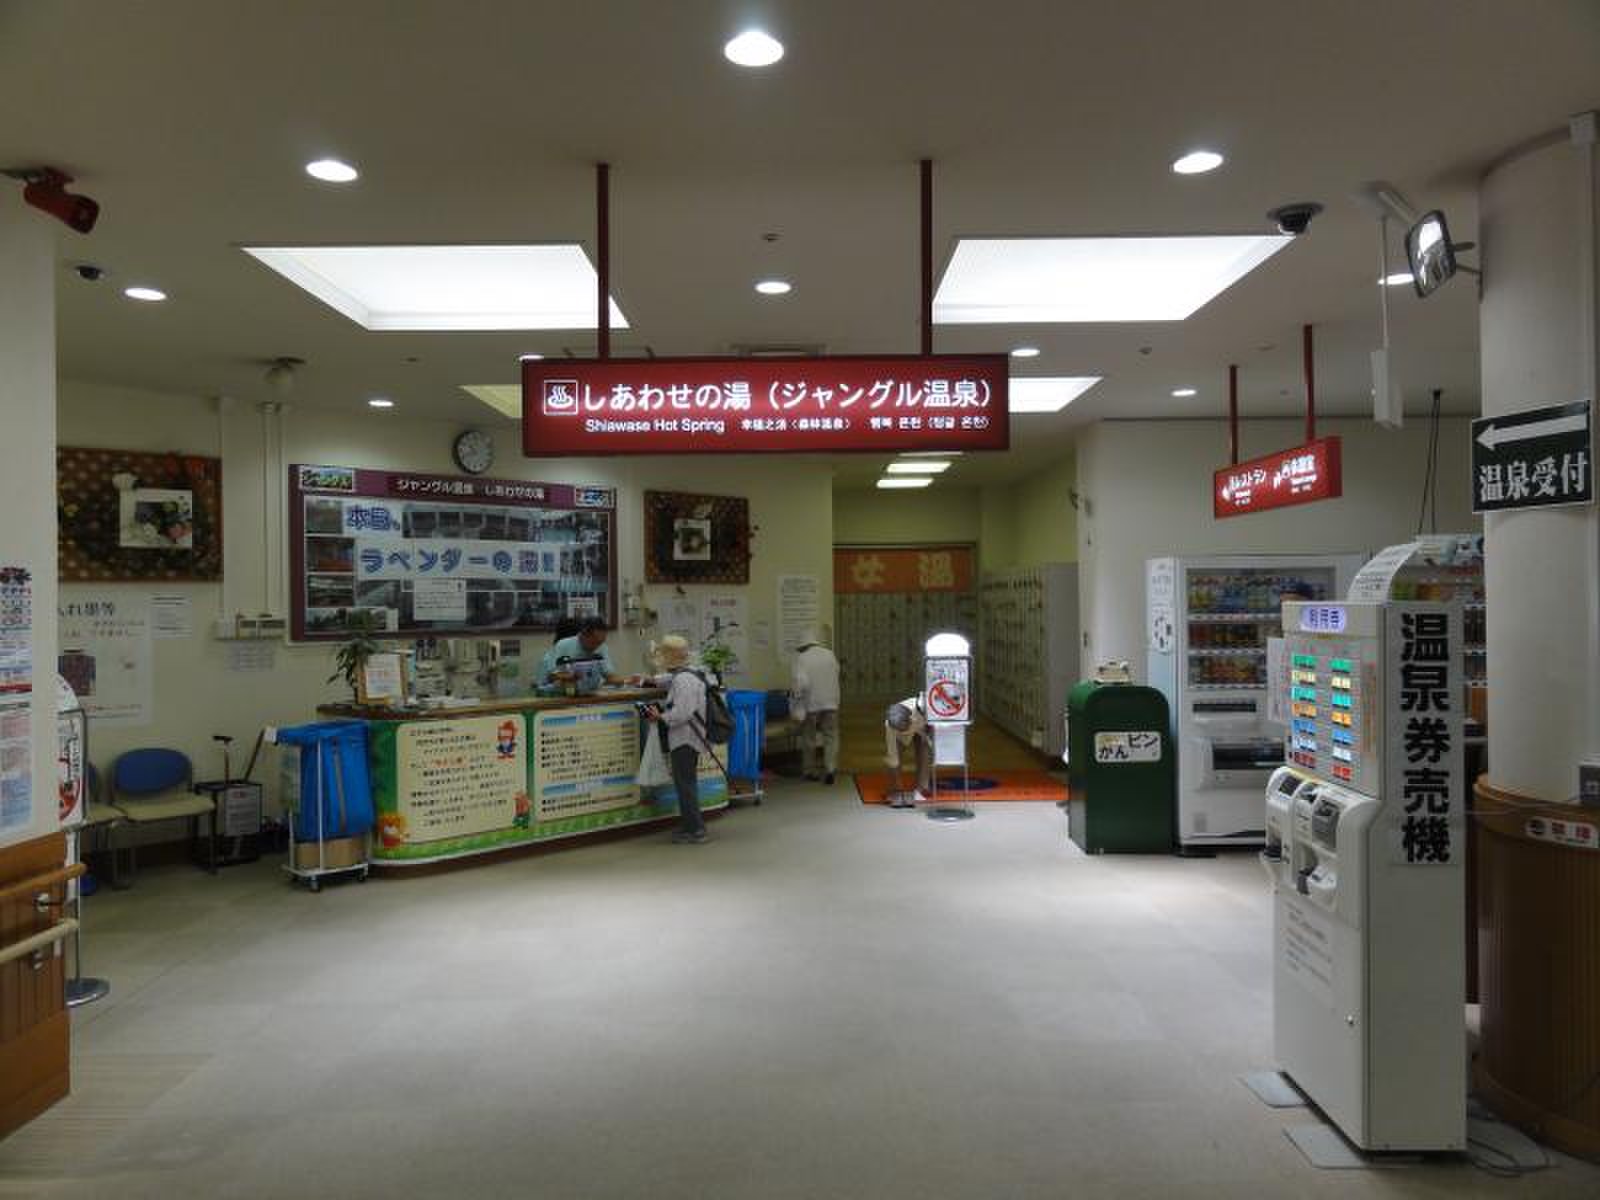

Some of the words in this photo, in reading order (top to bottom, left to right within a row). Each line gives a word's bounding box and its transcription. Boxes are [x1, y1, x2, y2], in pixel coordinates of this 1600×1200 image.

[585, 418, 651, 433] Shiawase
[653, 418, 678, 432] Hot
[682, 417, 725, 435] Spring
[1479, 451, 1588, 502] 温泉受付
[1401, 612, 1450, 864] 温泉券売機
